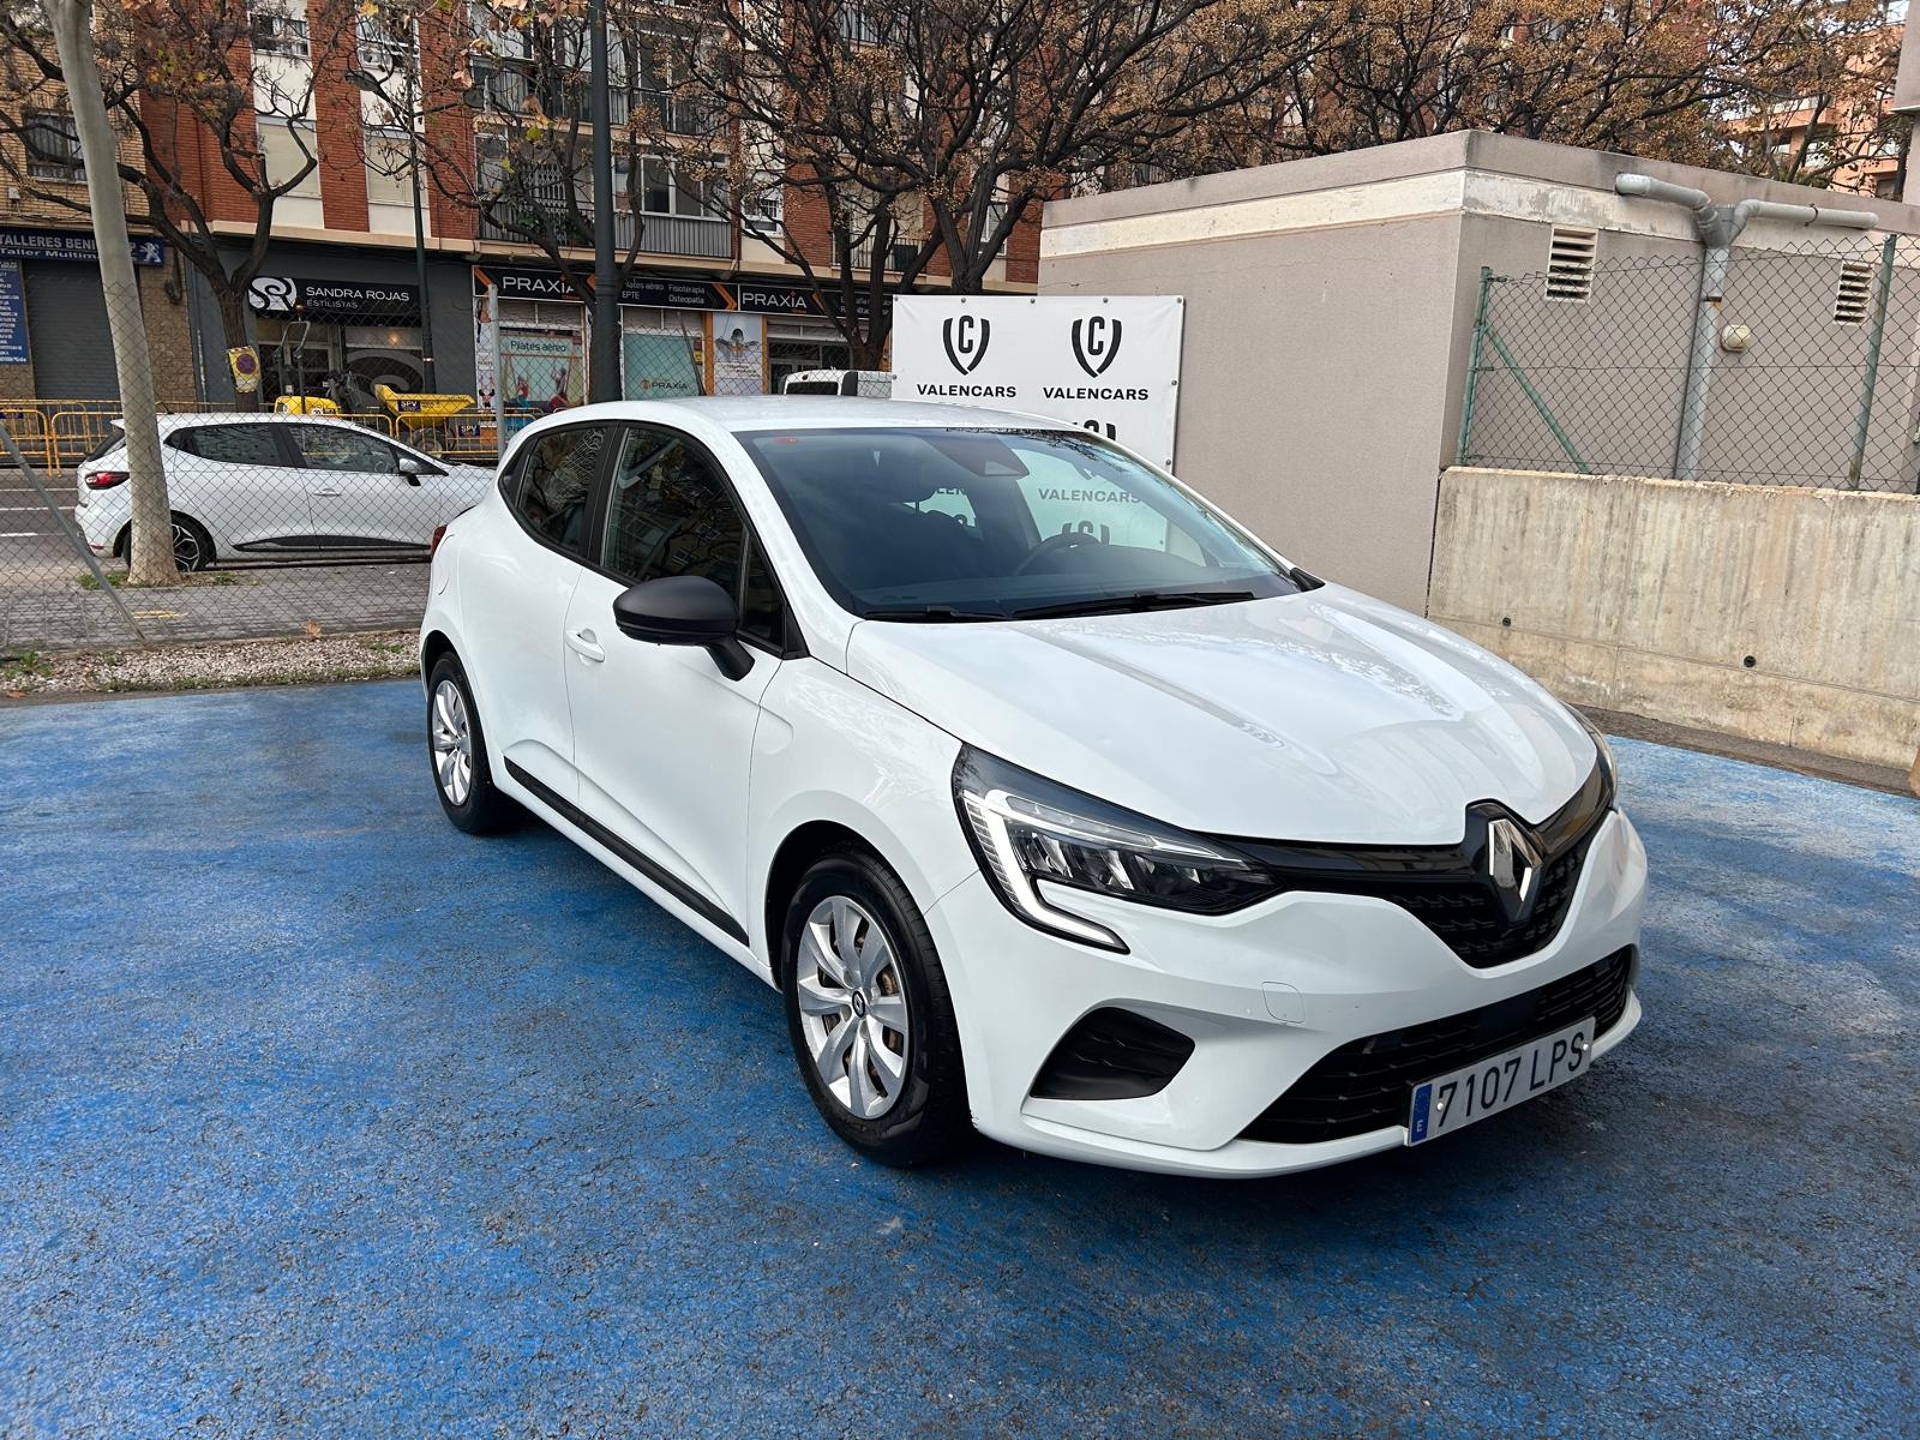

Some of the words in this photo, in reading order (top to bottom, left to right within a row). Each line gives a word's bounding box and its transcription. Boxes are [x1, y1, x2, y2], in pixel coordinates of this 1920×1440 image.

[0, 234, 62, 248] TALLERES
[0, 248, 41, 257] Taller
[306, 286, 363, 299] SANDRA
[366, 290, 410, 301] ROJAS
[306, 299, 358, 309] ESTILISTAS
[916, 383, 1017, 398] VALENCARS
[1043, 387, 1149, 401] VALENCARS
[1438, 1056, 1521, 1128] 7107
[1529, 1031, 1585, 1092] LPS
[1416, 1118, 1424, 1133] E
